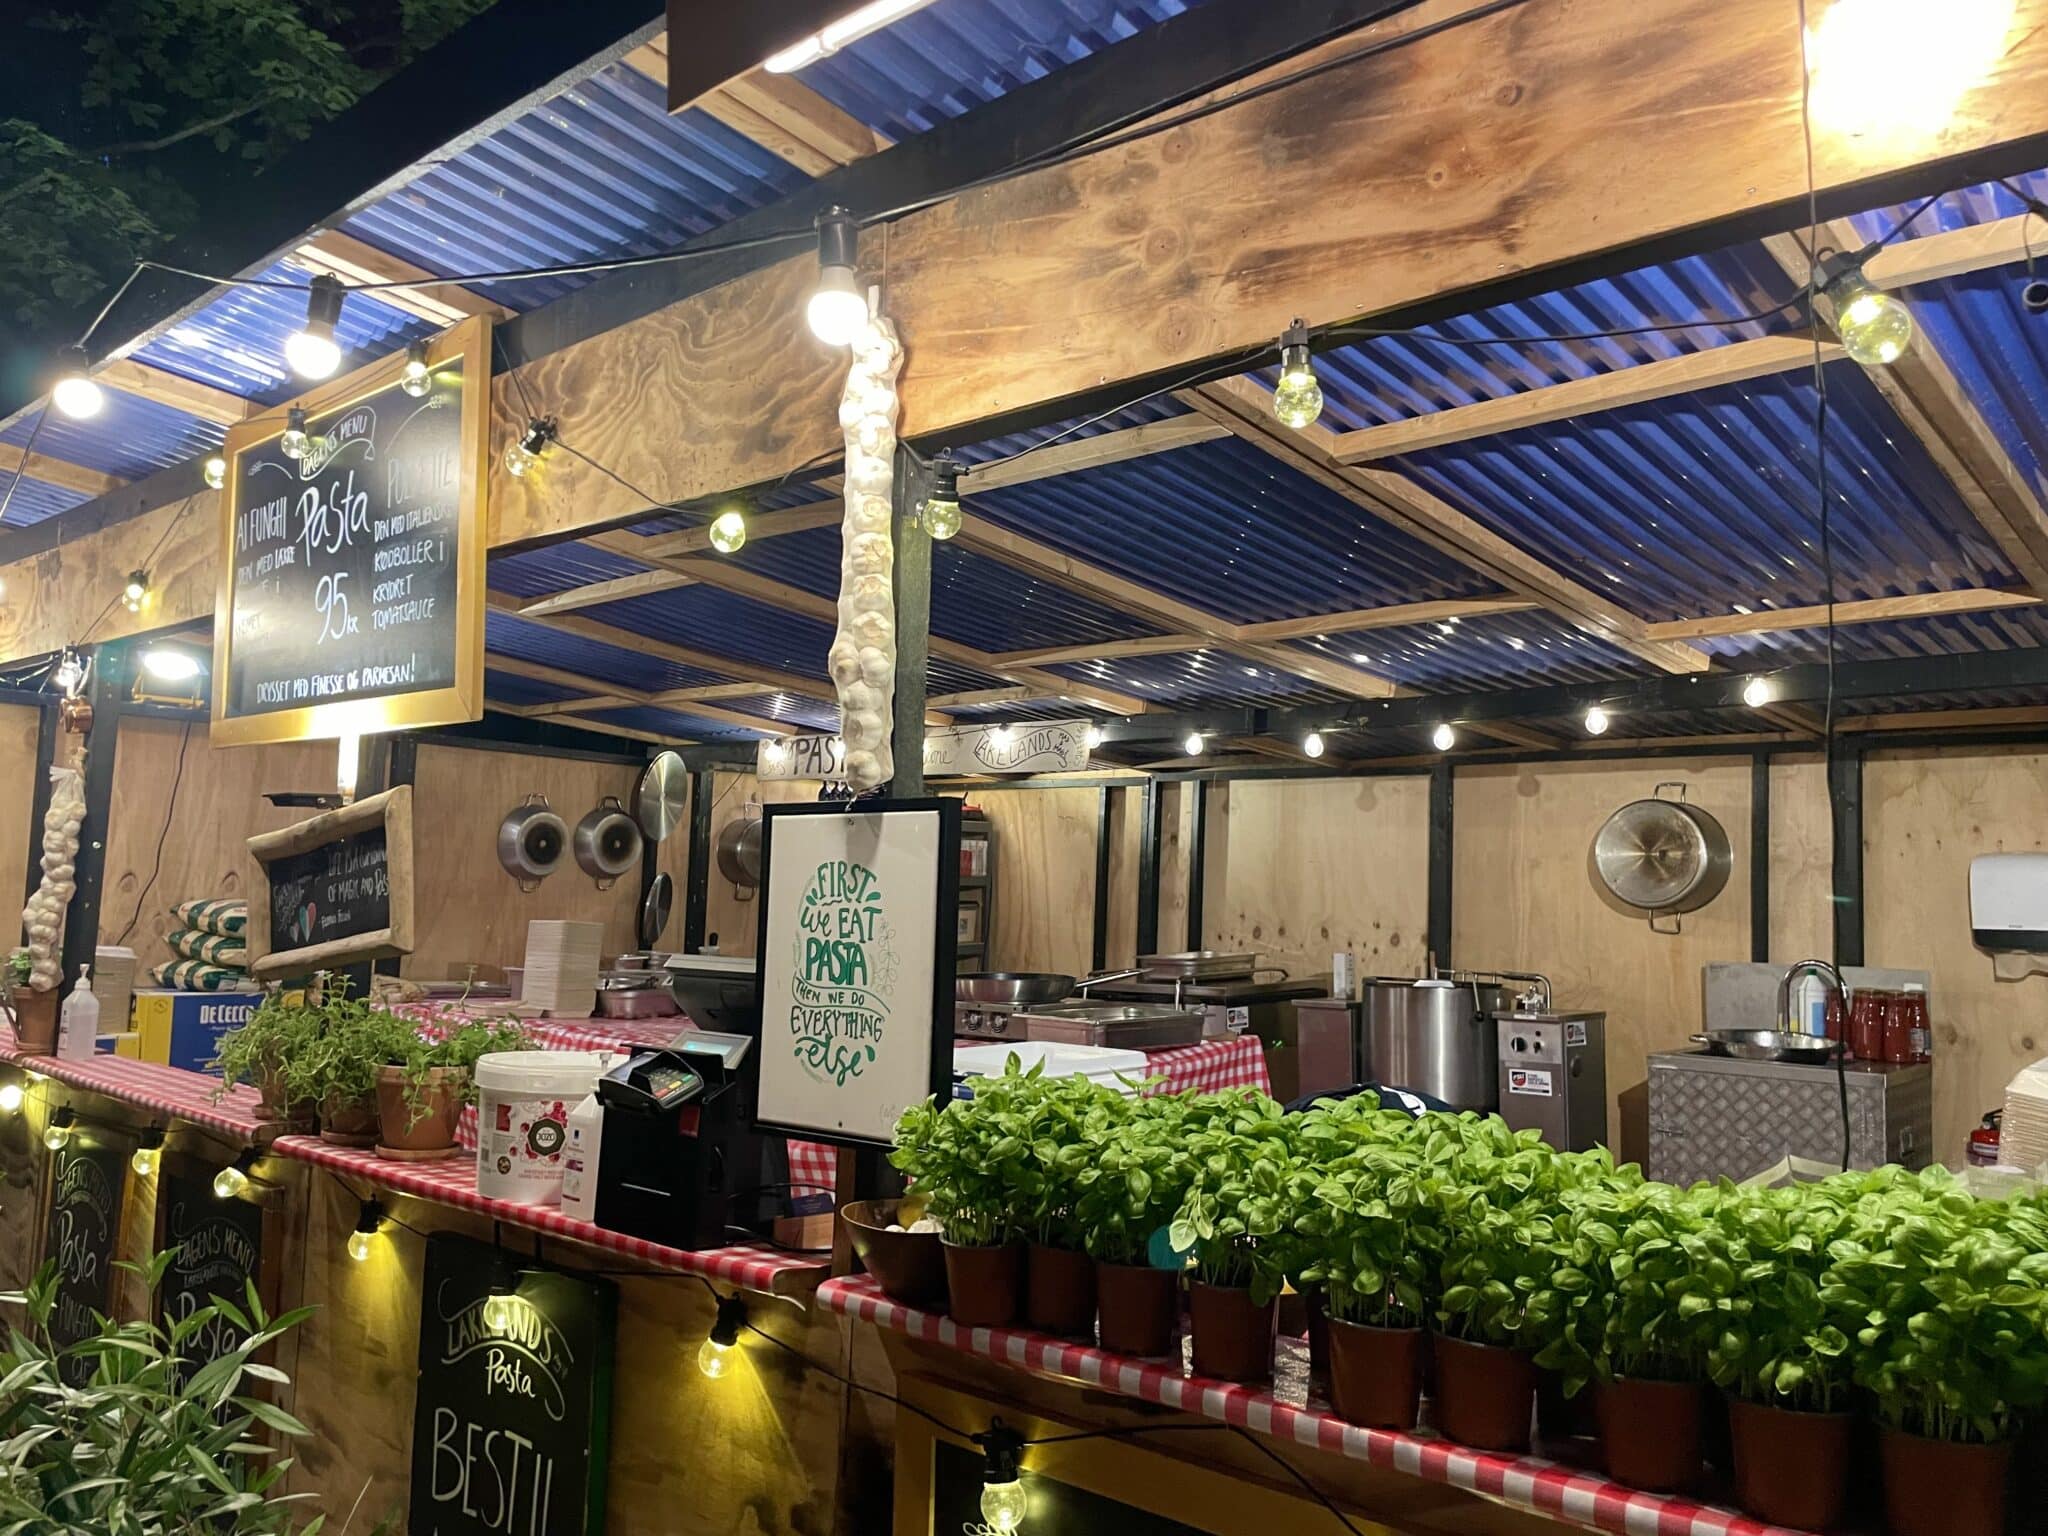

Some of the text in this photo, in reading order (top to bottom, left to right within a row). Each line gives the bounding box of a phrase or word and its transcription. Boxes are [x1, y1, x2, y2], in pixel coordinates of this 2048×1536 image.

[341, 415, 368, 440] MENU
[250, 496, 288, 547] FUNGHI
[296, 470, 371, 567] Pasta
[374, 520, 390, 543] DEN
[391, 514, 405, 537] MED
[256, 553, 274, 577] MED
[374, 539, 434, 572] KØDBOLLER
[373, 573, 414, 604] KRYDRET
[371, 597, 436, 630] TOMATSAUCE
[257, 652, 416, 704] DRYSSET MED FINESSE OG PARMESAN!
[328, 883, 336, 903] OF
[360, 876, 374, 896] AND
[817, 860, 877, 903] FIRST
[838, 906, 883, 943] EAT
[805, 937, 868, 986] PASTA
[795, 977, 865, 1006] THEN WE DO
[791, 1005, 883, 1043] EVERYTHING
[796, 1033, 864, 1087] else
[57, 1209, 98, 1288] Pasta
[177, 1224, 256, 1274] DAGENS MENU
[485, 1348, 536, 1399] Pasta
